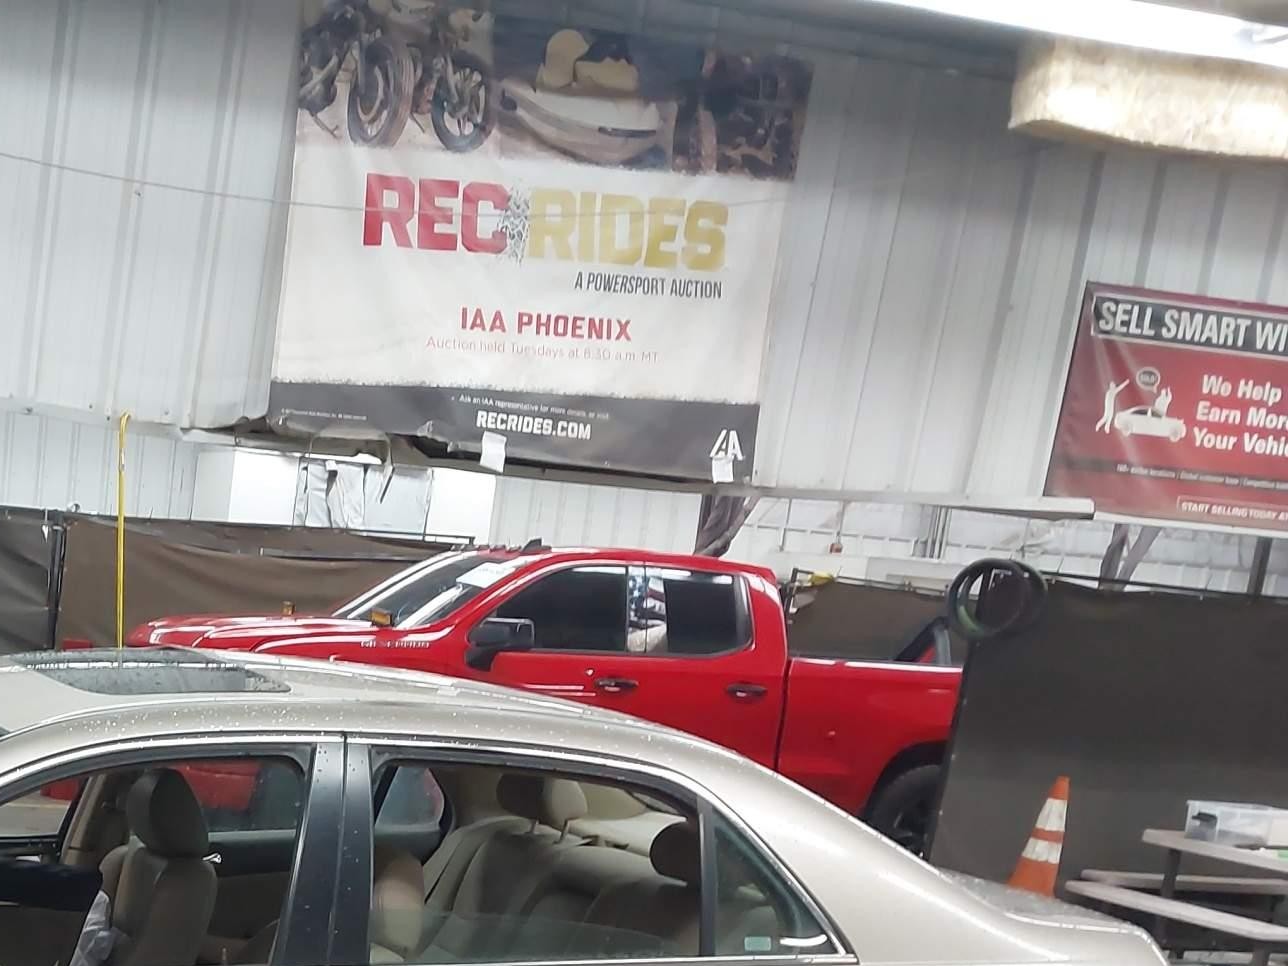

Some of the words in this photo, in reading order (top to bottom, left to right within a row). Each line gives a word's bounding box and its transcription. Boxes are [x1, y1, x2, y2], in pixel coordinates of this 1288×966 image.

[362, 172, 510, 255] REC
[528, 187, 730, 272] RIDES
[574, 271, 584, 290] A
[586, 273, 666, 297] POWERSPORT
[669, 278, 722, 300] AUCTION
[461, 306, 507, 334] IAA
[517, 311, 632, 342] PHOENIX
[1098, 301, 1156, 337] SELL
[1161, 308, 1252, 348] SMART
[425, 335, 476, 352] Auction
[1201, 374, 1232, 397] We
[1237, 378, 1282, 407] Help
[476, 410, 592, 440] RECRIDES.COM
[1196, 400, 1241, 426] Earn
[1246, 406, 1288, 431] Mor
[1192, 427, 1239, 452] Your
